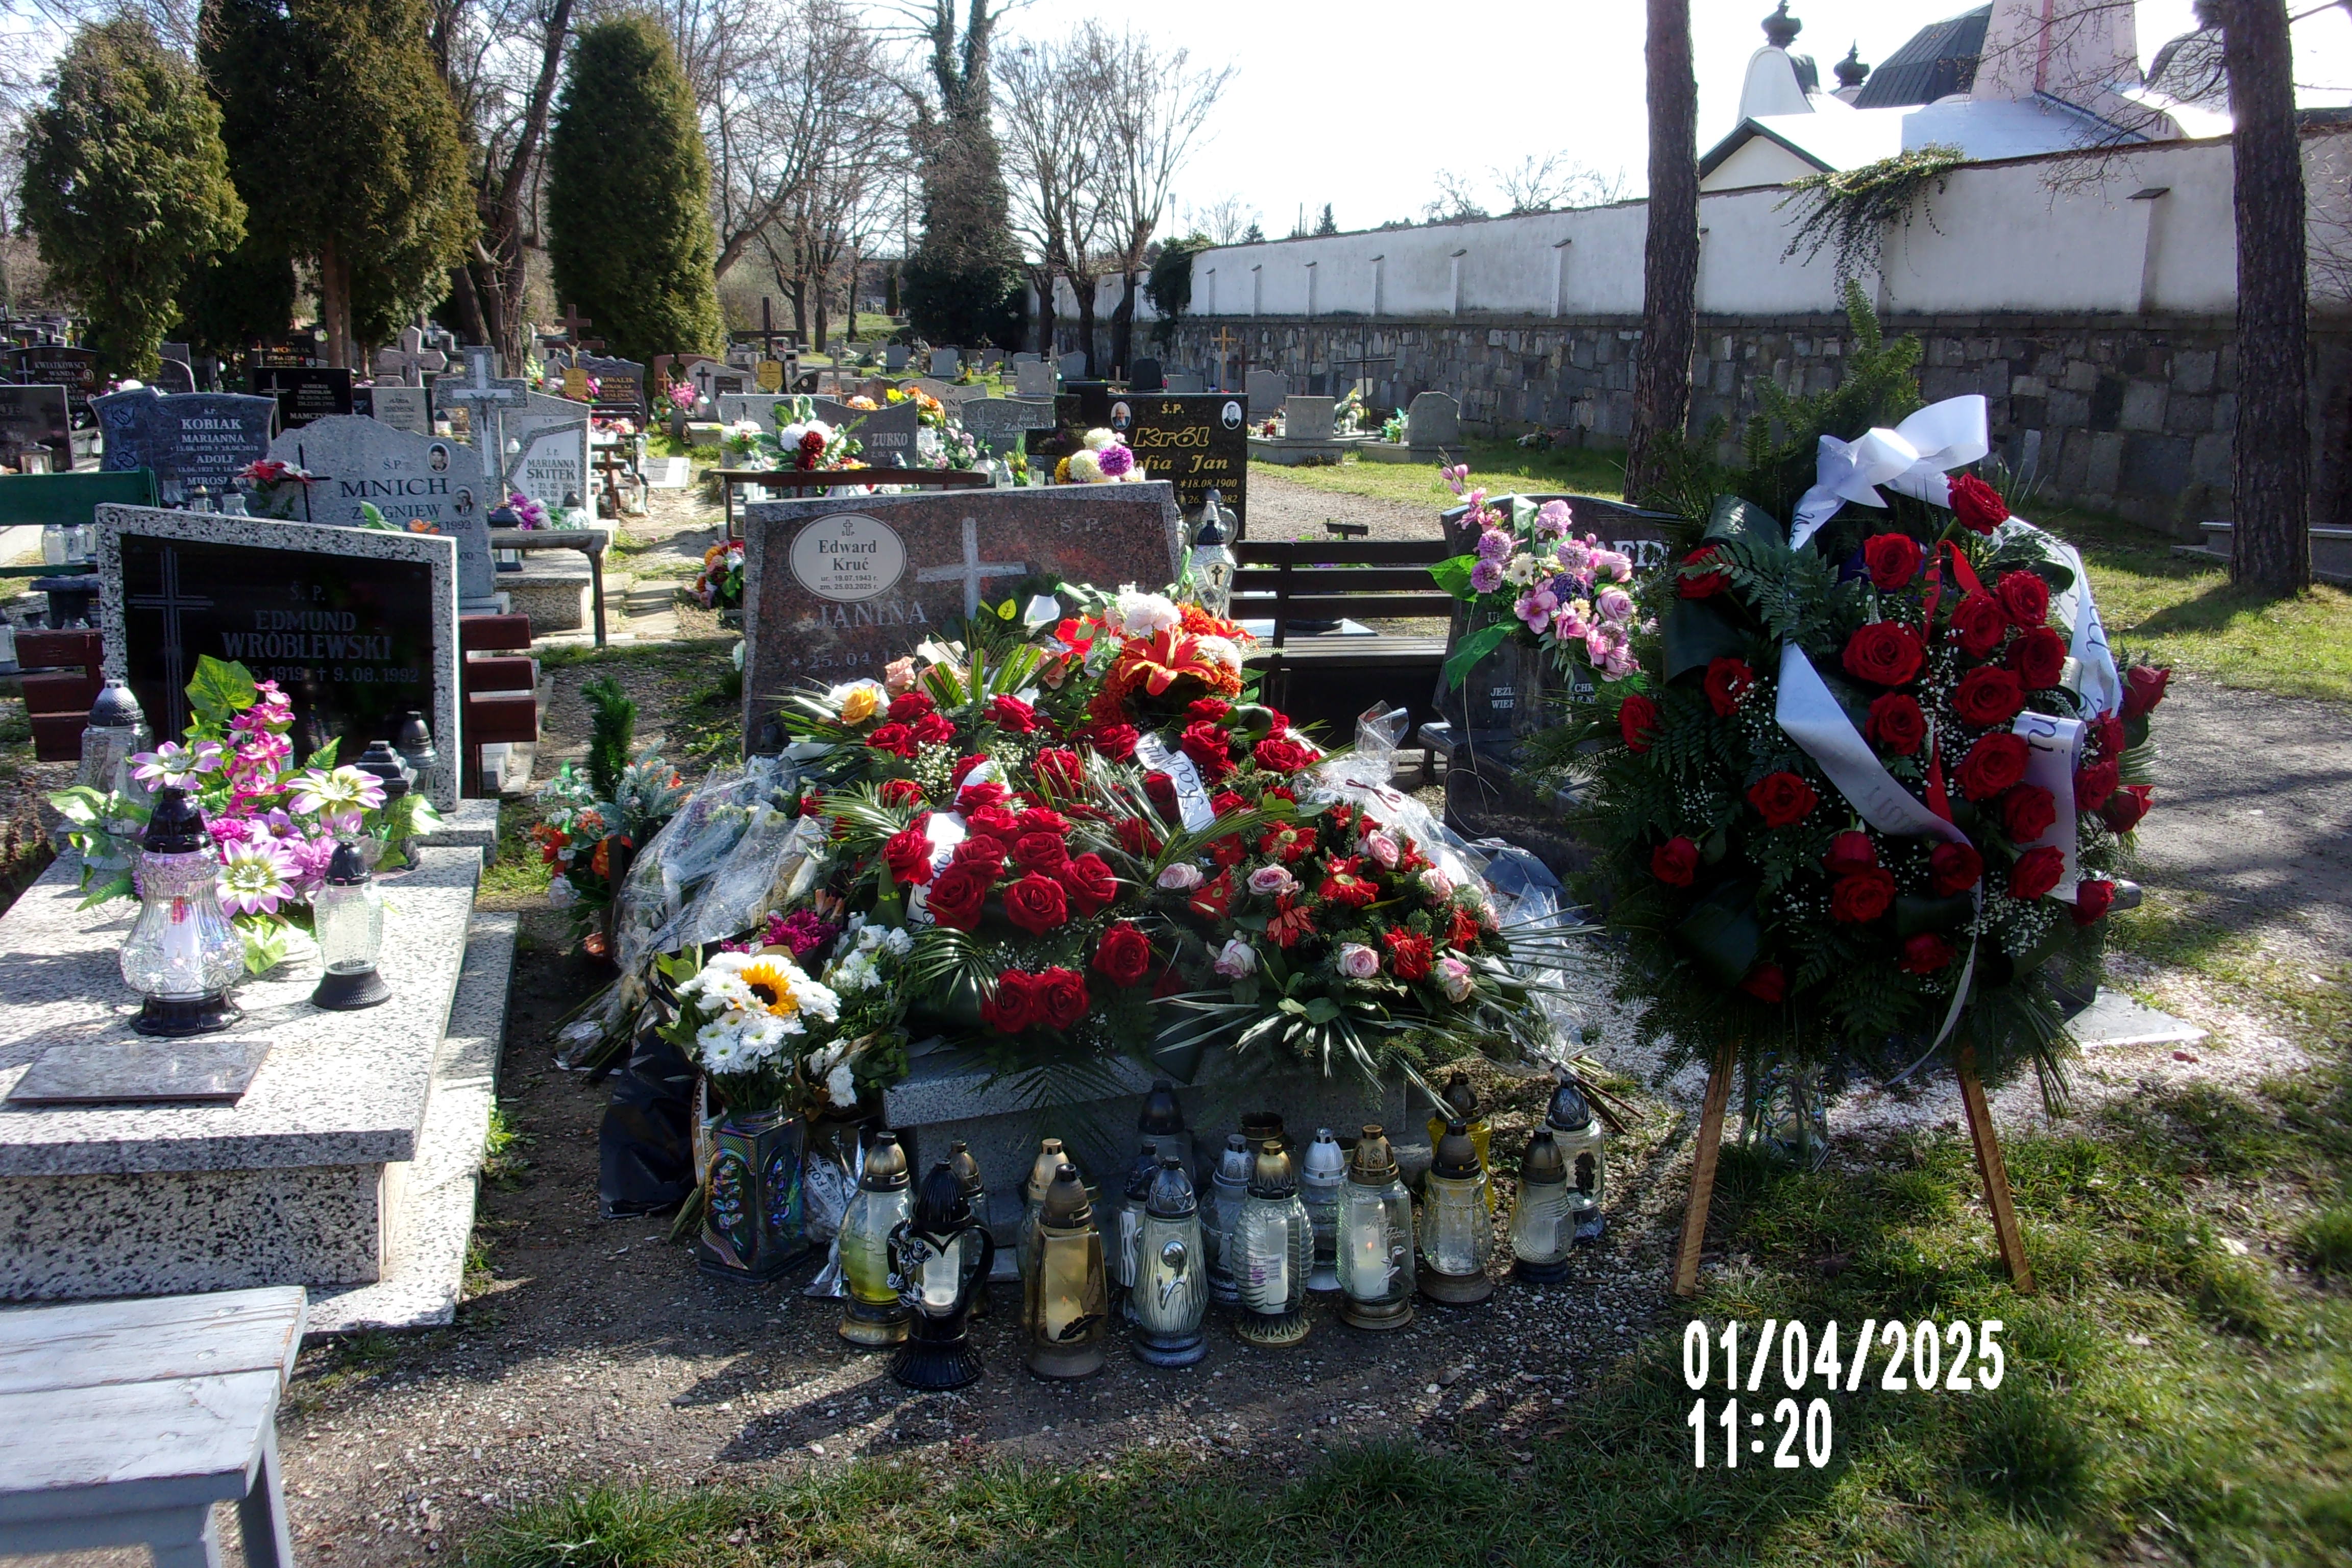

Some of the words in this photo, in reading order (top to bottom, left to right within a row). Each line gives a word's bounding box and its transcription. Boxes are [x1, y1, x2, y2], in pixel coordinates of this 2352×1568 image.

[181, 419, 242, 430] KOBIAK
[181, 434, 246, 443] MARIANNA
[871, 433, 909, 447] ZUBKO
[1133, 427, 1210, 447] Król
[197, 455, 235, 463] ADOLF
[527, 459, 576, 468] MARIANNA
[1134, 455, 1172, 471] ofia
[1188, 454, 1228, 473] Jan
[526, 469, 576, 480] SKITEK
[339, 478, 450, 498] MNICH
[351, 504, 442, 519] ZGNIEW
[818, 540, 877, 553] Edward
[832, 557, 869, 571] Kruć
[255, 610, 356, 631] EDMUND
[818, 601, 929, 629] JANINA
[220, 630, 392, 659] WRÓBLEWSKI
